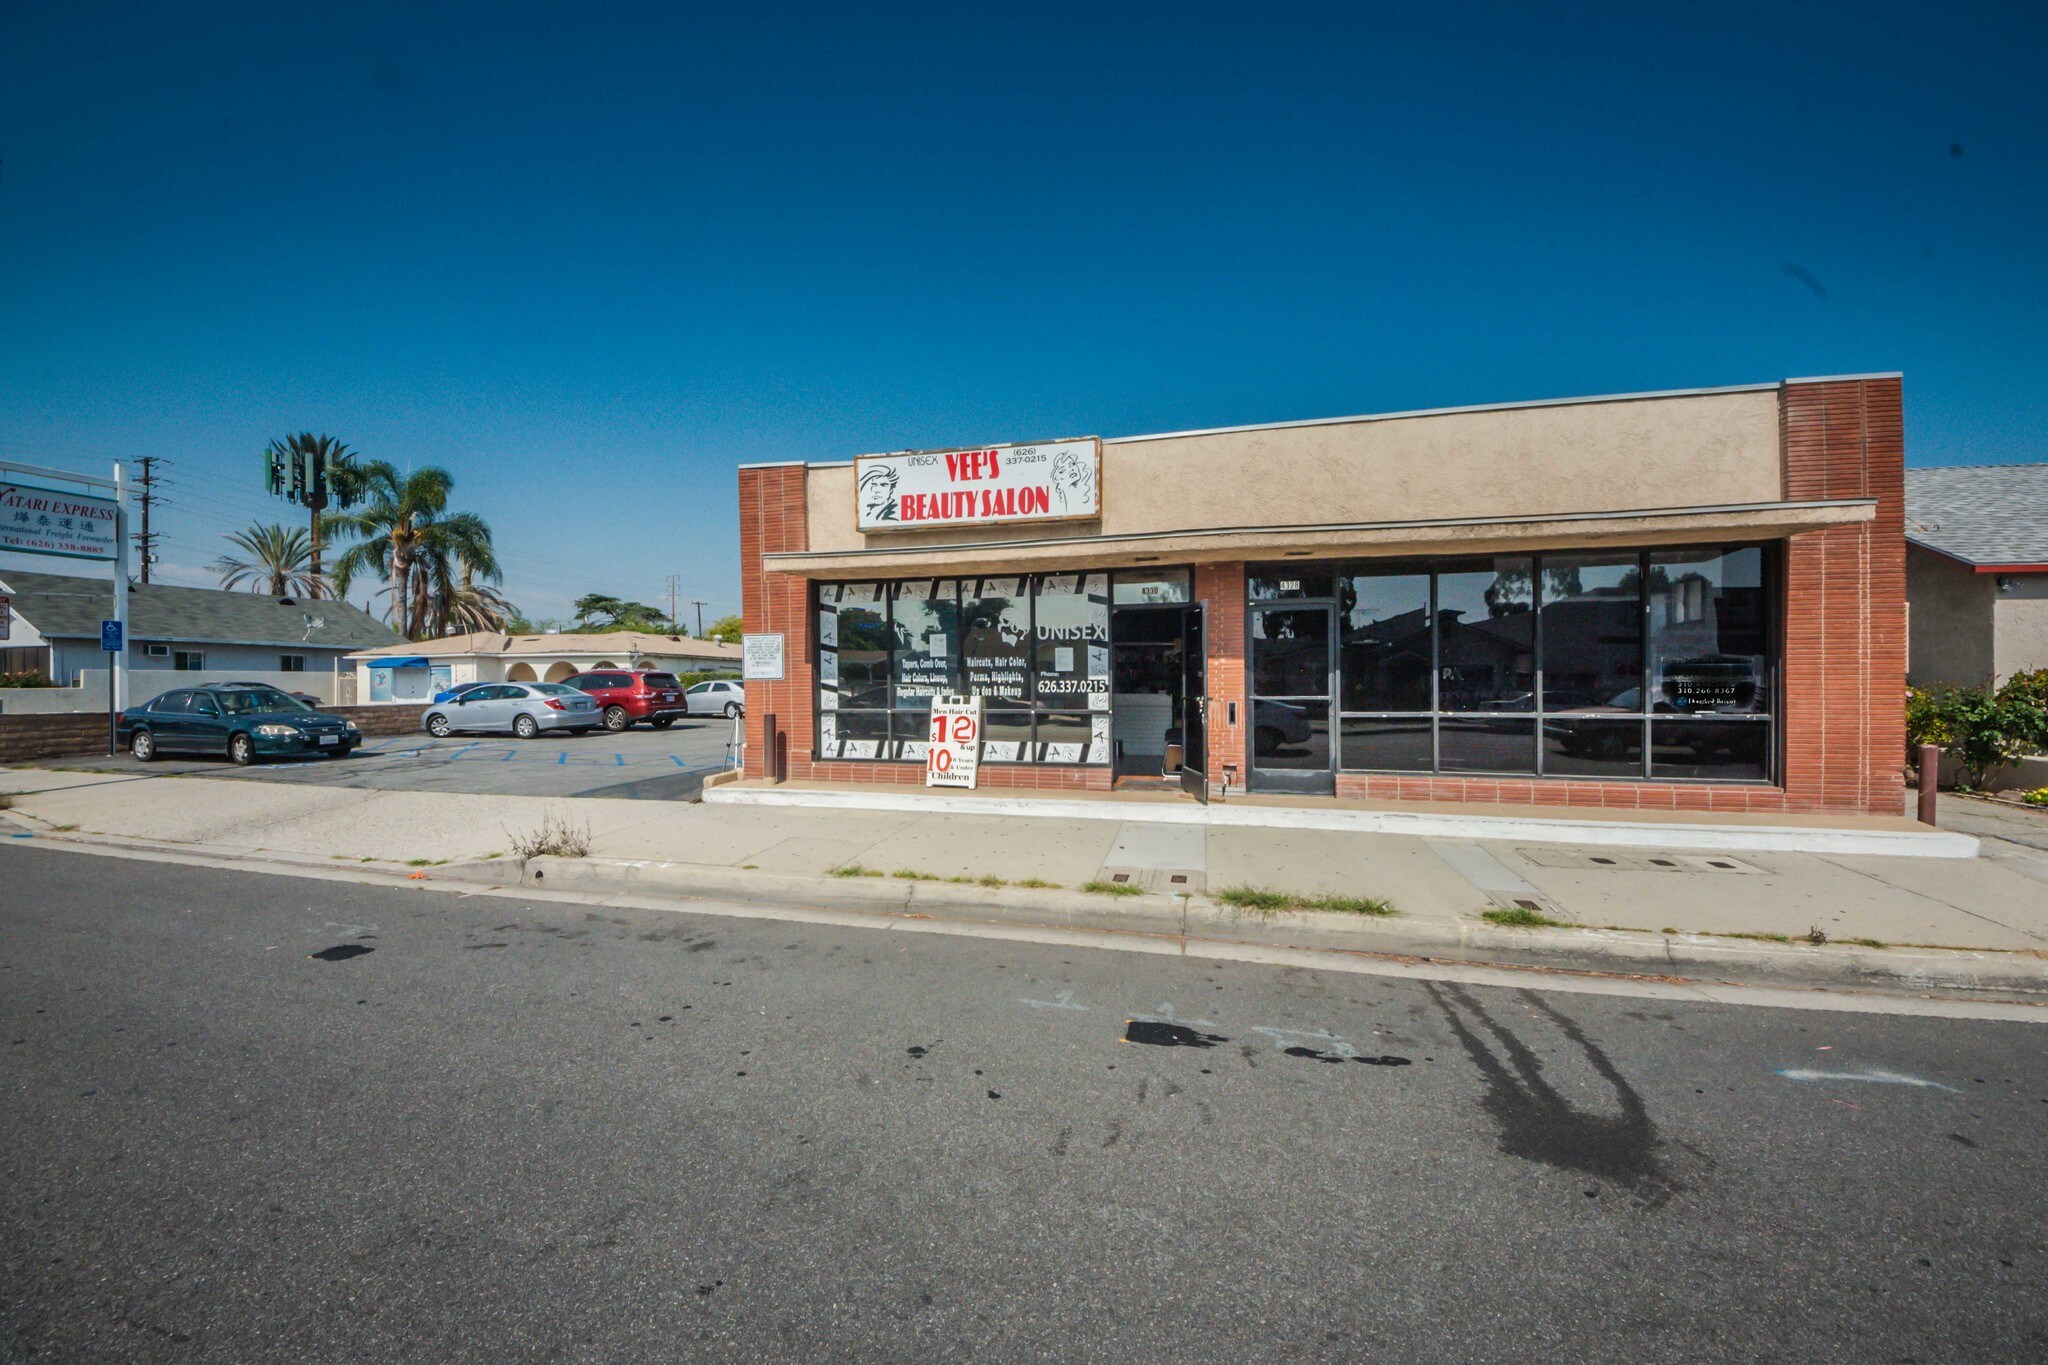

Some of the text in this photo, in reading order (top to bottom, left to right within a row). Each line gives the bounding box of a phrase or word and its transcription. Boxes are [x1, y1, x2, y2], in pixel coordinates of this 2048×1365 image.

[1013, 448, 1036, 456] (626)
[908, 455, 938, 466] UNISEX
[945, 450, 999, 482] VEE'S
[1005, 454, 1047, 465] 337-0215
[901, 485, 1049, 521] BEAUTY SALON
[52, 501, 114, 520] EXPRESS
[0, 525, 114, 544] ernational Freight Forwarder
[2, 535, 104, 554] Tel: (626) 338-8885
[1037, 624, 1105, 640] UNISEX
[920, 659, 934, 669] Comb
[935, 658, 948, 670] Over,
[967, 656, 1027, 669] Haircuts, Hair Color,
[970, 671, 1024, 683] Perms, Highlights,
[1000, 685, 1022, 697] Makeup
[1038, 680, 1105, 693] 626.337.0215
[928, 748, 951, 773] 10
[932, 772, 970, 780] Children
